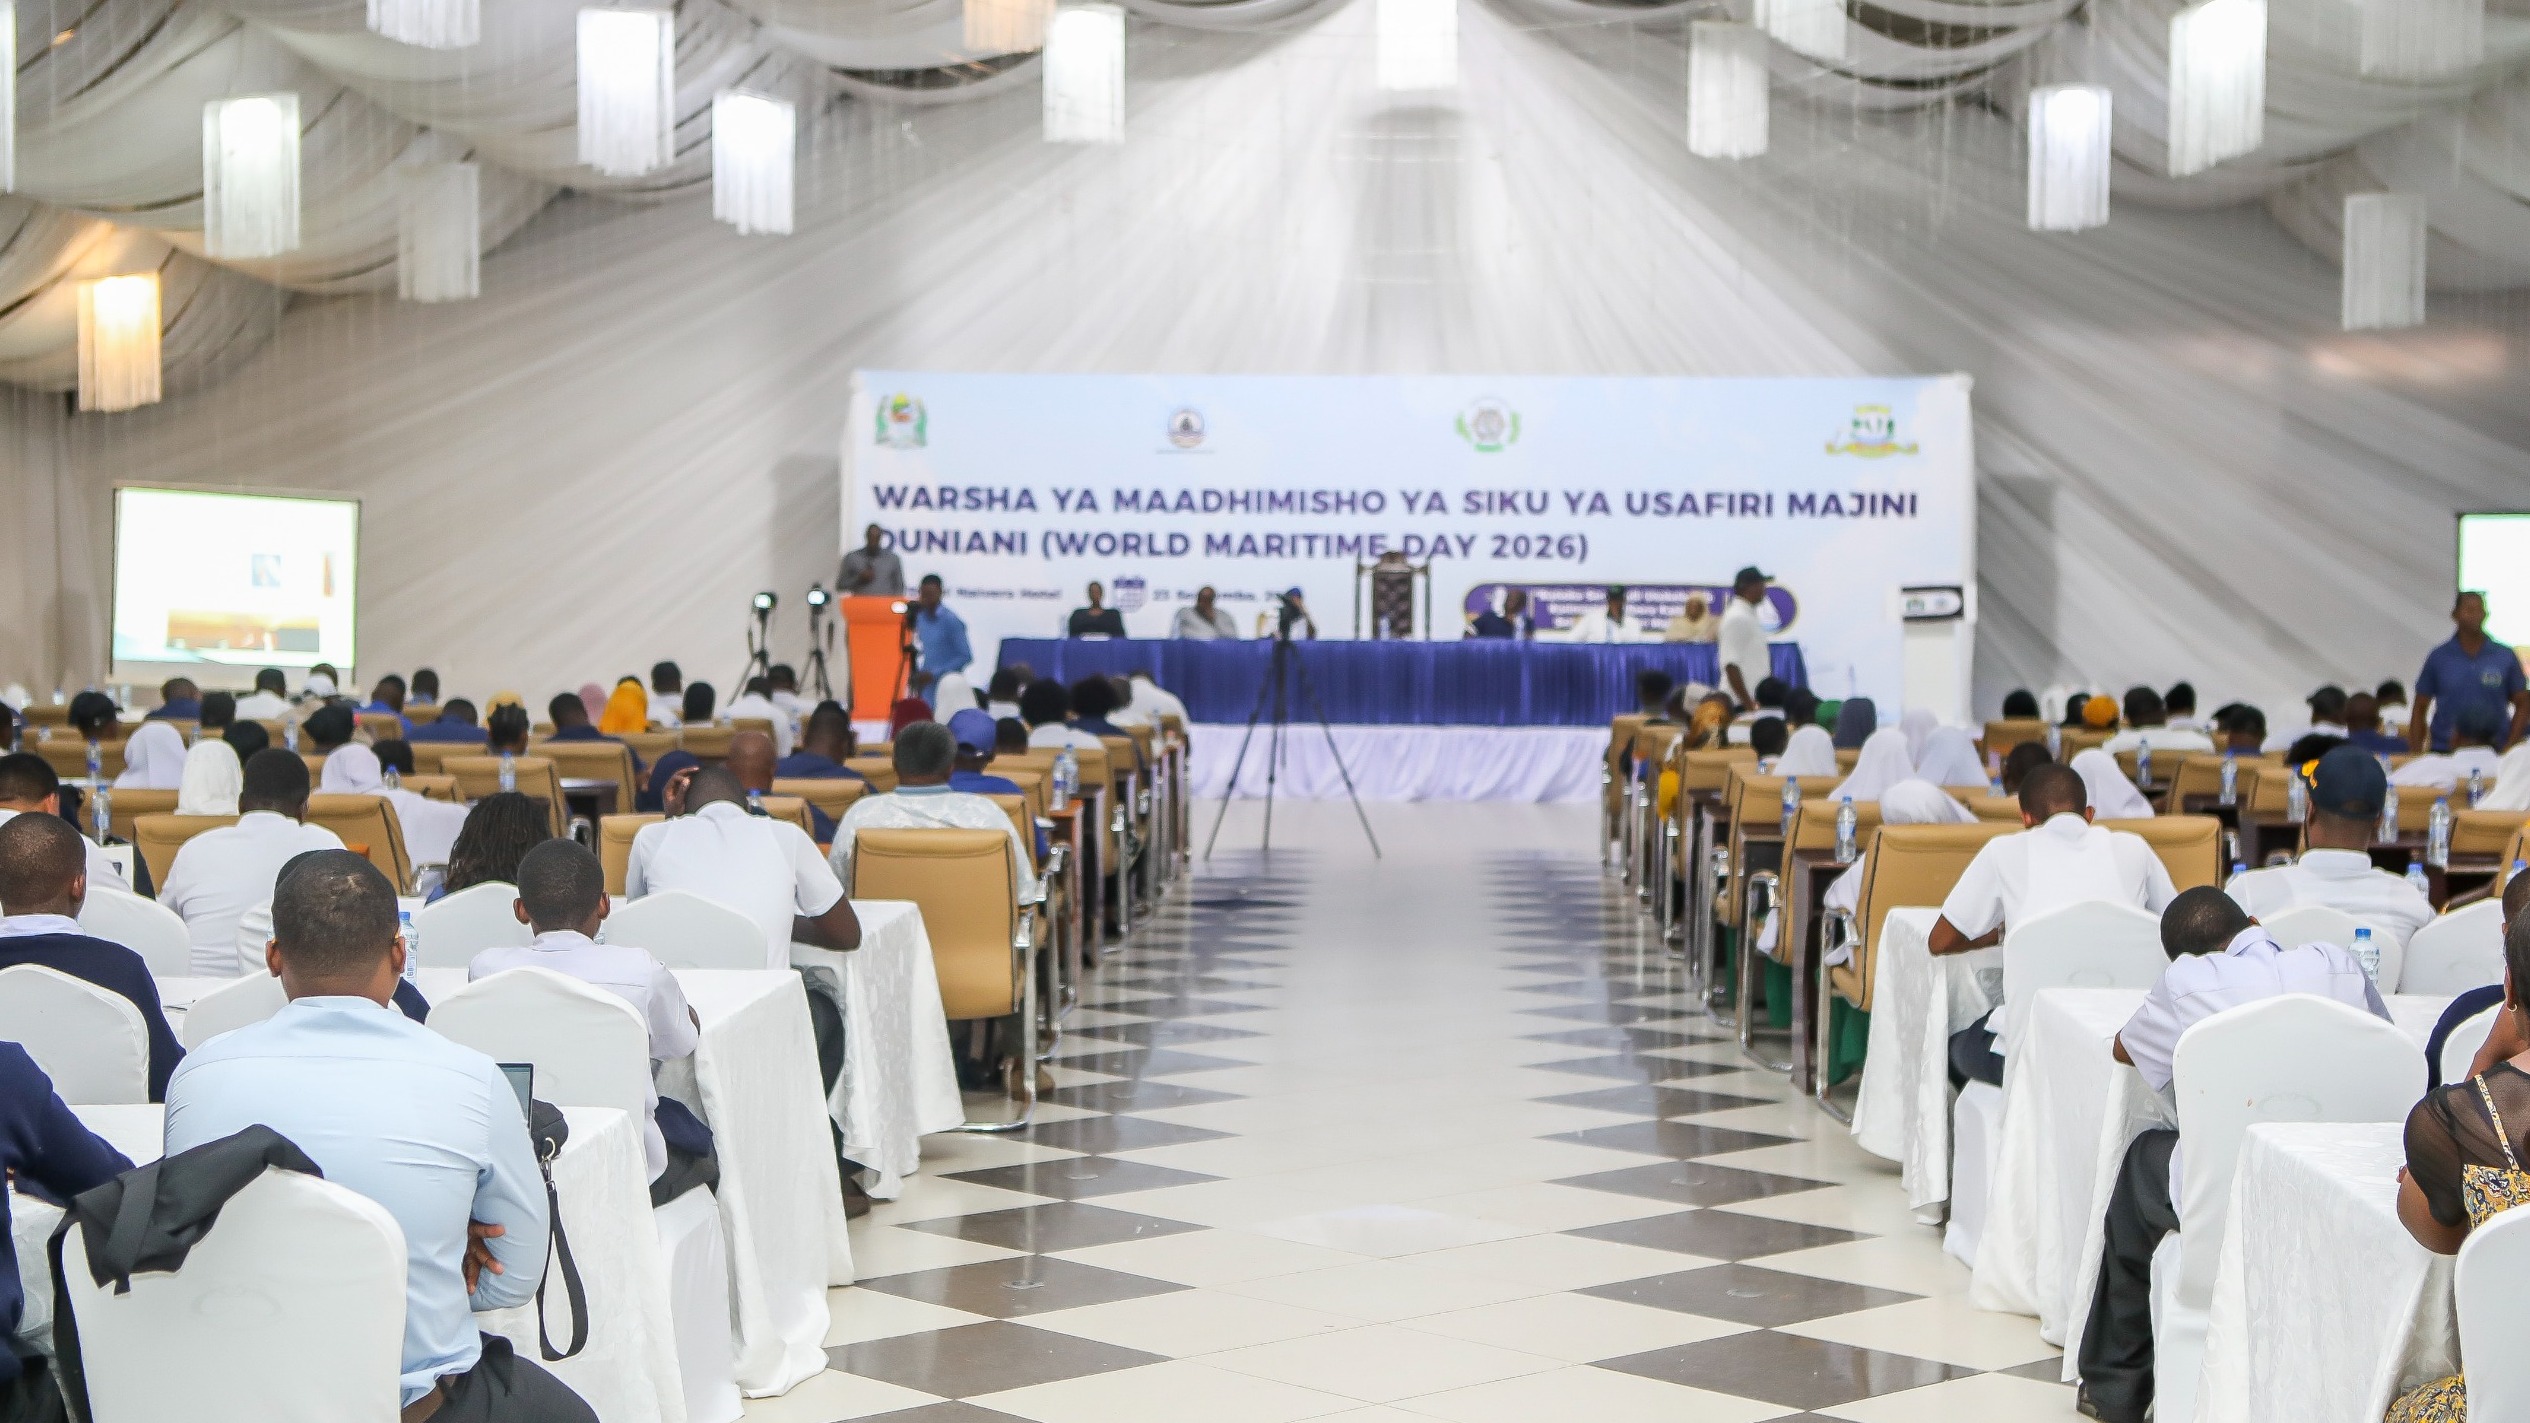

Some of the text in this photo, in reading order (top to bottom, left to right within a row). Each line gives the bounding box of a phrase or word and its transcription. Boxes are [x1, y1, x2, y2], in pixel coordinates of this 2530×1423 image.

[872, 484, 1918, 518] WARSHA YA MAADHIMISHO YA SIKU YA USAFIRI MAJINI
[1040, 530, 1191, 560] (WORLD
[1204, 533, 1387, 558] MARITIME
[1402, 534, 1477, 559] DAY
[1491, 534, 1589, 564] 2026)
